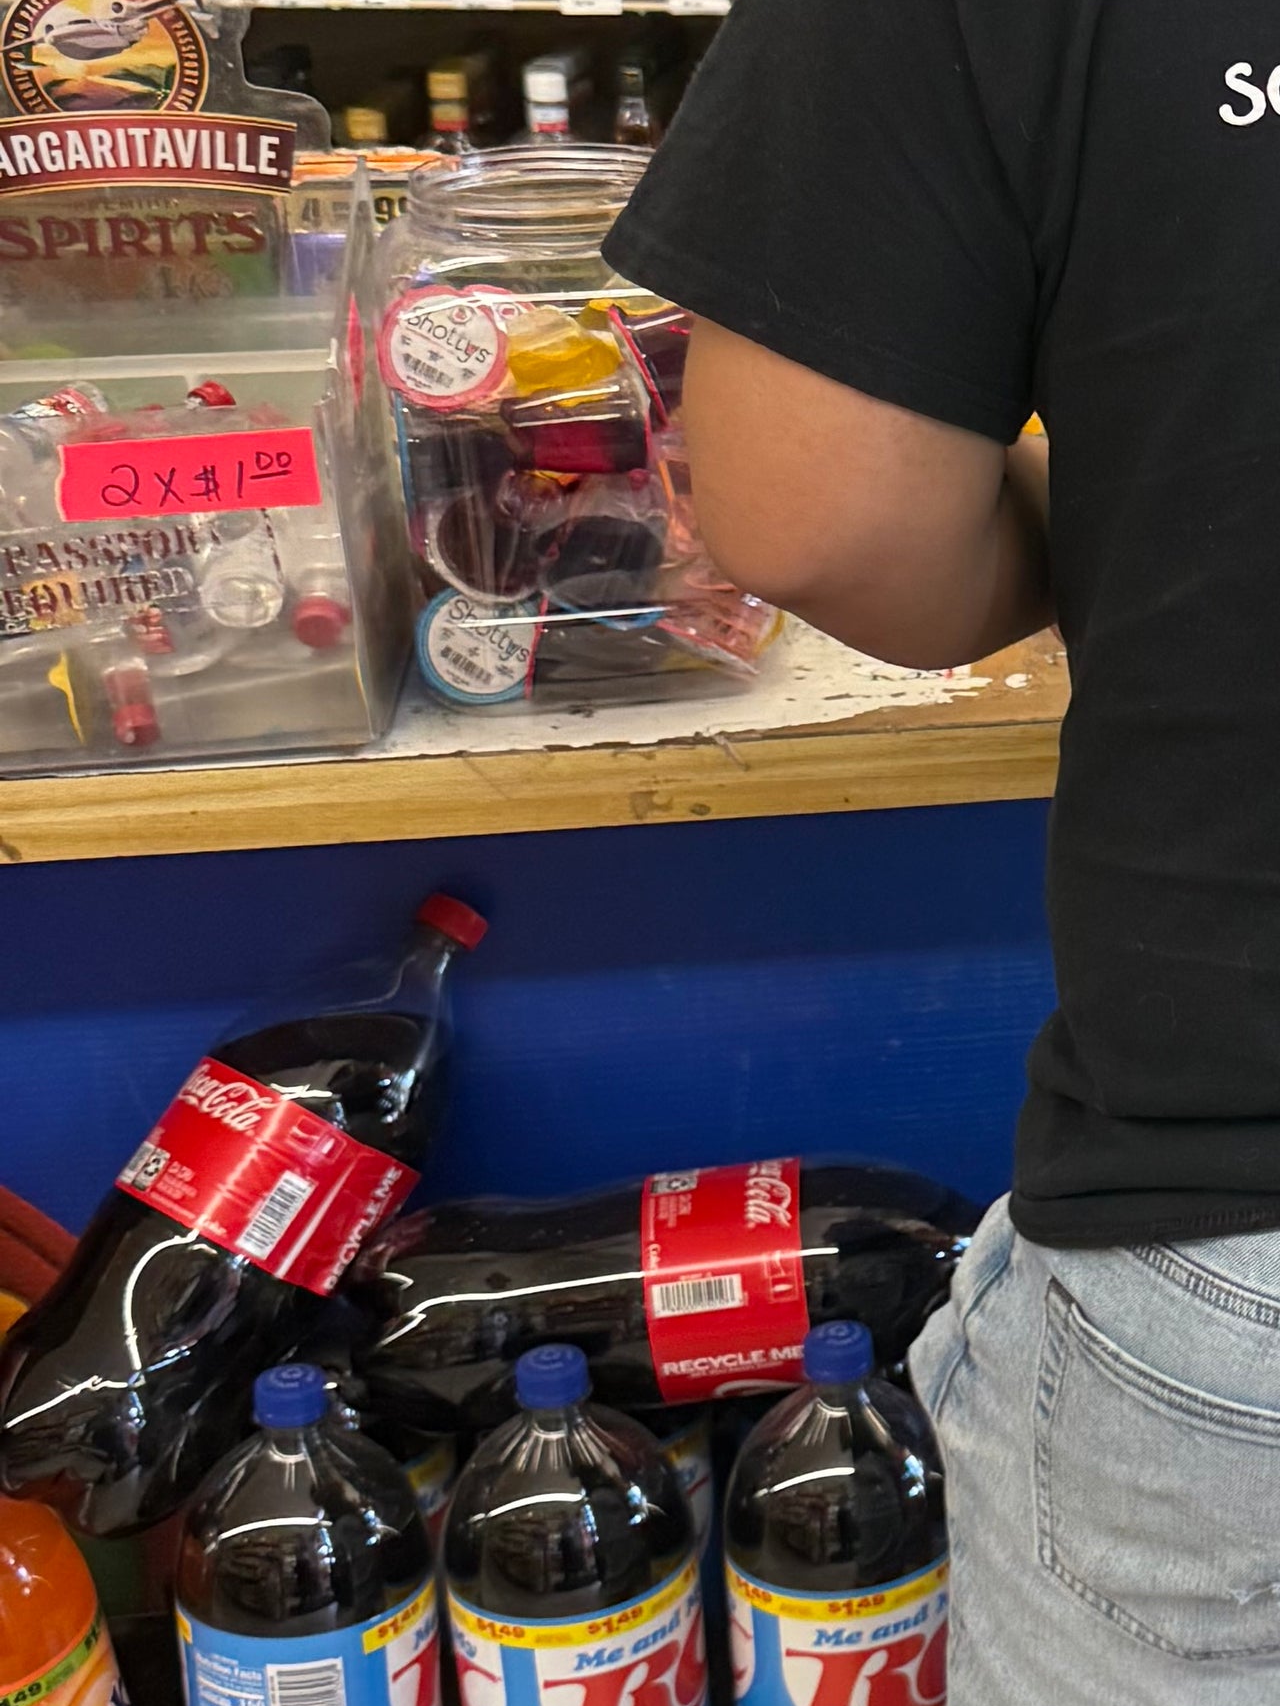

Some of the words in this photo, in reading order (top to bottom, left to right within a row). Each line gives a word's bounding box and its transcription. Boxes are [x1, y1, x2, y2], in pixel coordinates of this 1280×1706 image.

[0, 127, 280, 178] ARGARITAVILLE
[0, 210, 268, 262] SPIRITS
[100, 463, 143, 507] 2
[0, 566, 195, 622] EQUIRED
[661, 1349, 767, 1377] RECYCLE
[769, 1344, 805, 1363] ME
[587, 1606, 644, 1636] $1.49
[813, 1624, 862, 1649] Me
[865, 1605, 925, 1641] and
[826, 1592, 888, 1618] $1.49
[476, 1617, 526, 1640] $1.49
[573, 1647, 624, 1672] Me
[632, 1621, 680, 1655] and
